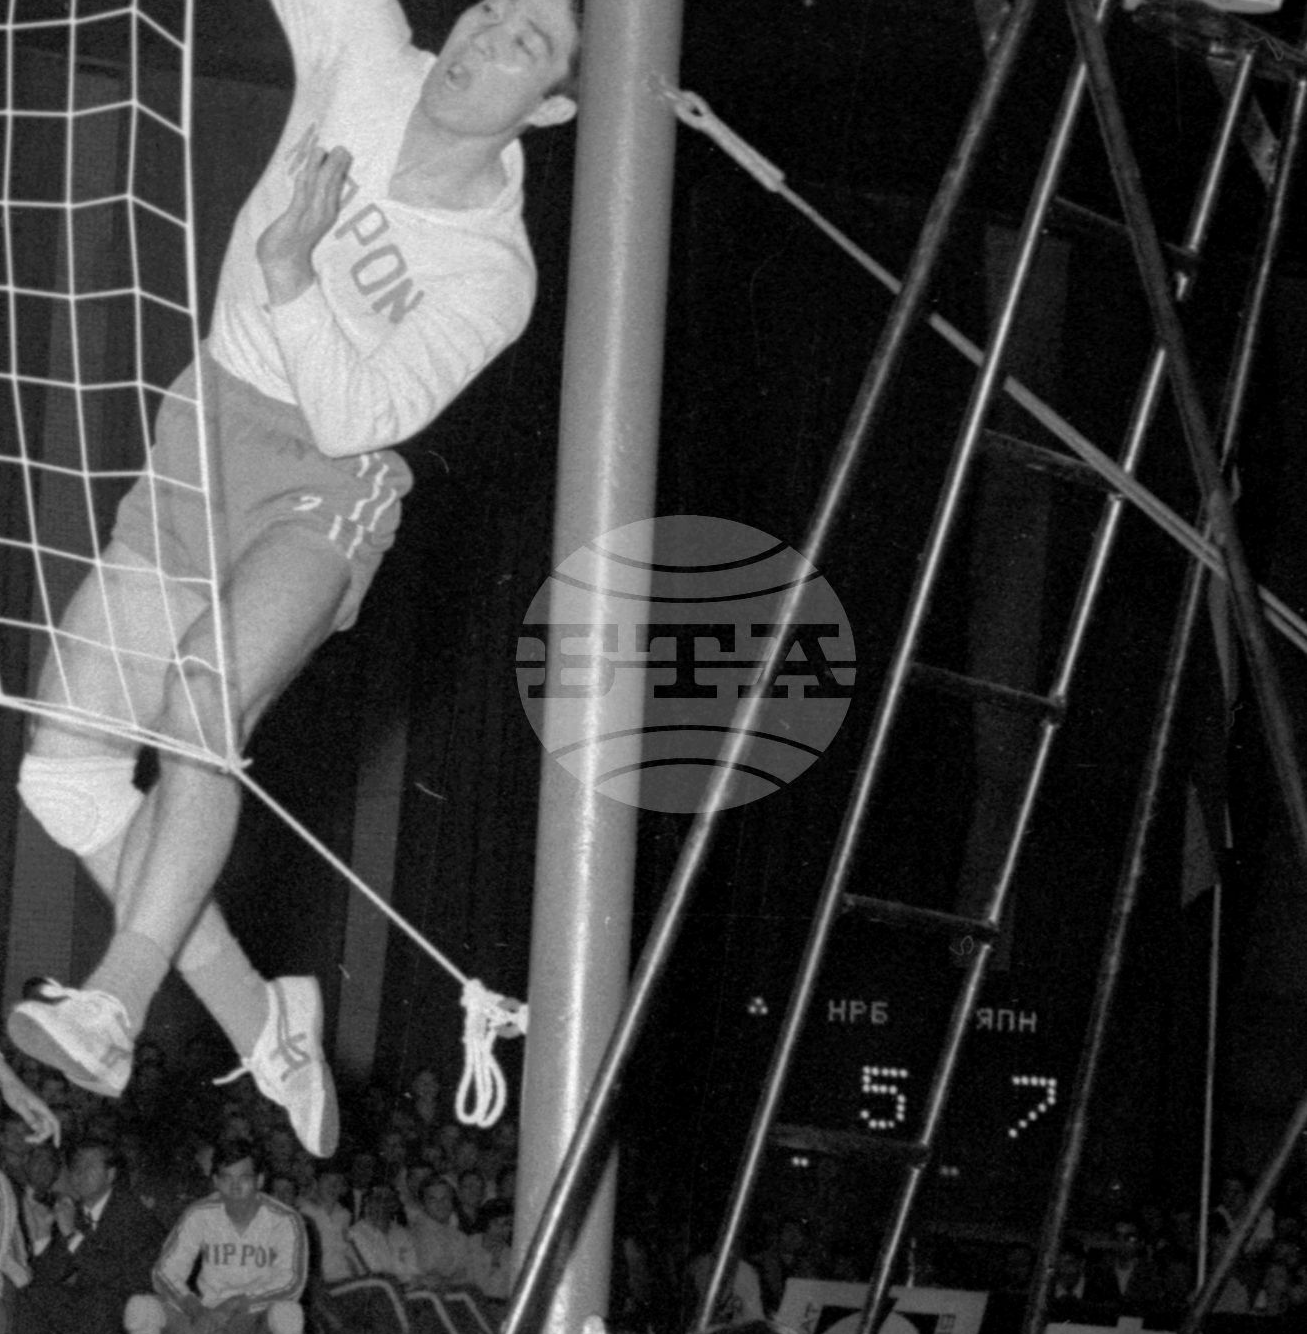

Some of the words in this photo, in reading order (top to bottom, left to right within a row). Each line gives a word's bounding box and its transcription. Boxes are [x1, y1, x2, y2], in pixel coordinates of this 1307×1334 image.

[828, 999, 889, 1025] НРБ
[976, 1007, 1037, 1033] ЯПН
[860, 1065, 909, 1129] 5
[1008, 1076, 1058, 1139] 7
